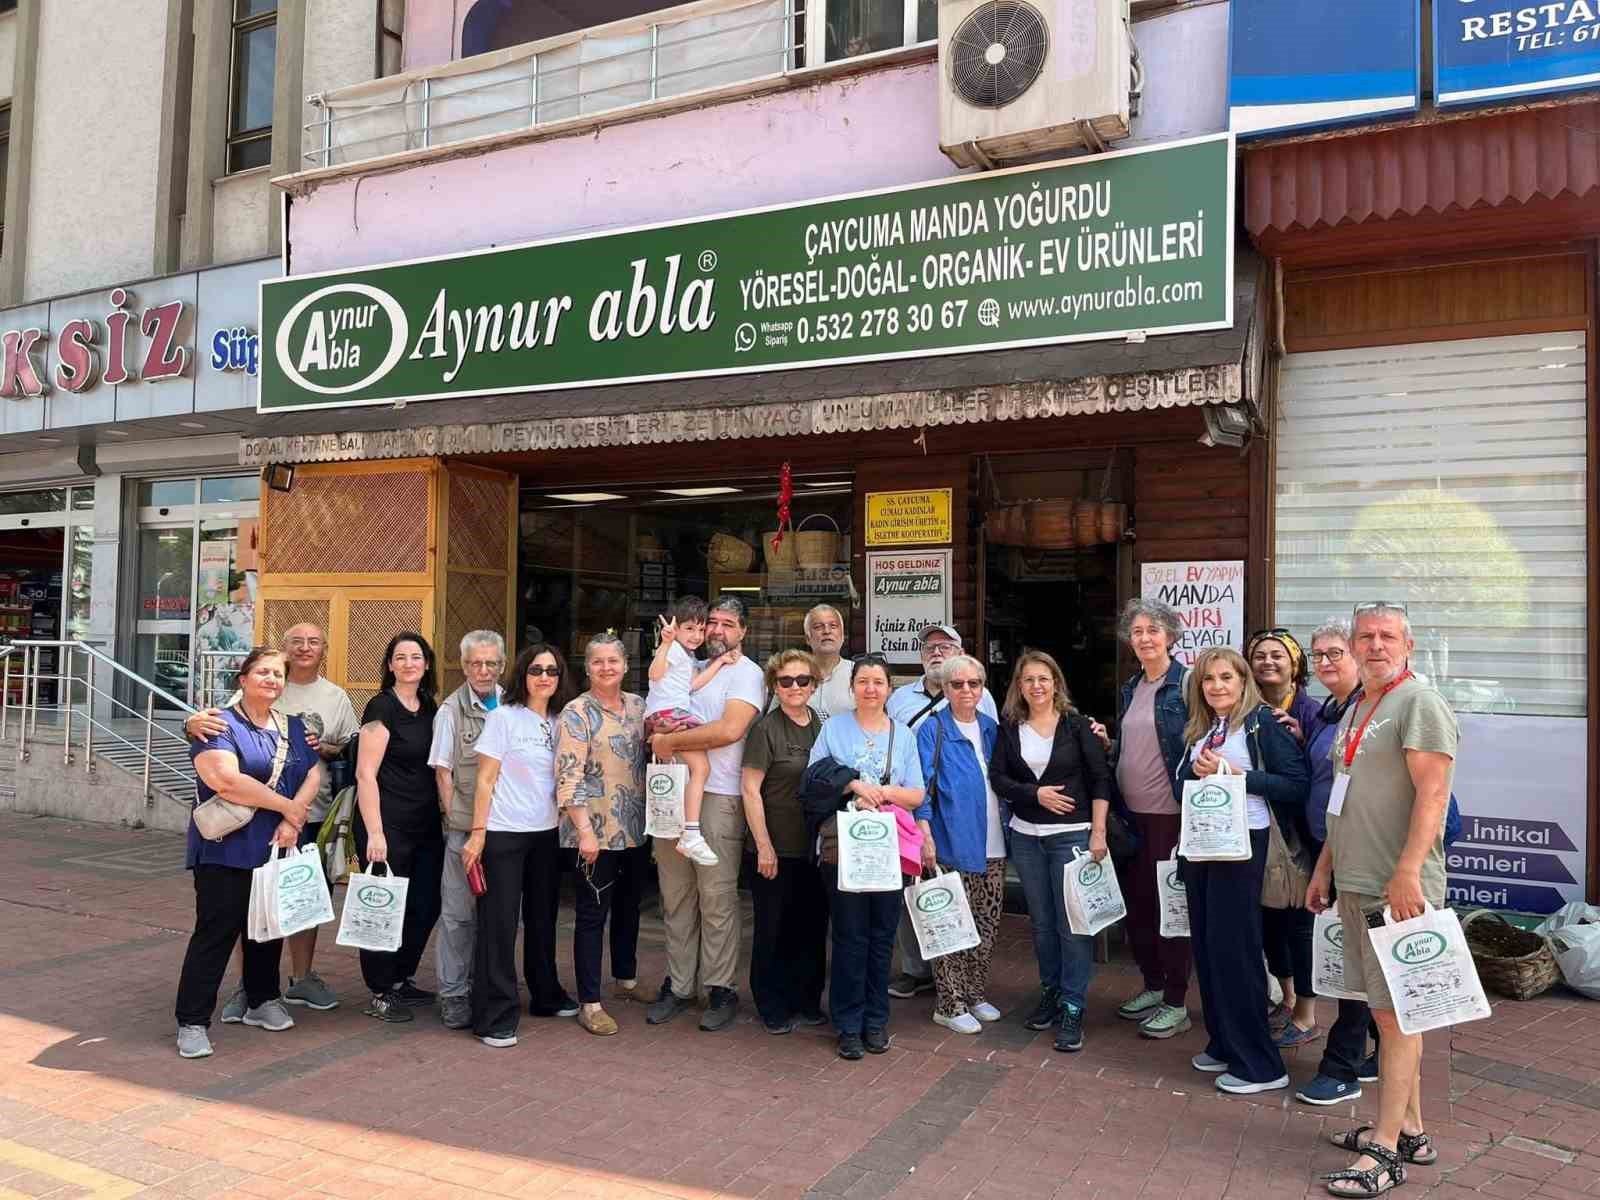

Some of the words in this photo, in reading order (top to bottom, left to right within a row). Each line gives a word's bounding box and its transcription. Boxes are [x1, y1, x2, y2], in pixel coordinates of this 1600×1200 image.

[1461, 0, 1600, 41] RESTA
[1514, 32, 1565, 51] TEL:
[805, 211, 905, 265] ÇAYCUMA
[910, 199, 988, 243] MANDA
[994, 180, 1111, 232] YOĞURDU
[1040, 237, 1071, 276] EV
[1077, 209, 1204, 272] ÜRÜNLERİ
[1008, 275, 1203, 320] www.aynurabla.com
[409, 288, 572, 382] Aynur
[588, 254, 716, 342] abla
[760, 320, 793, 334] Whatsapp
[797, 313, 853, 343] 0.532
[860, 307, 899, 337] 278
[907, 303, 933, 333] 30
[941, 300, 968, 328] 67
[765, 335, 788, 347] Sipariş
[875, 560, 895, 570] HOŞ
[897, 559, 940, 569] GELDİNİZ
[1187, 566, 1204, 582] EV
[877, 578, 912, 595] Aynur
[913, 576, 939, 591] abla
[1158, 584, 1235, 606] MANDA
[875, 615, 905, 637] İçiniz
[881, 637, 908, 652] Etsin
